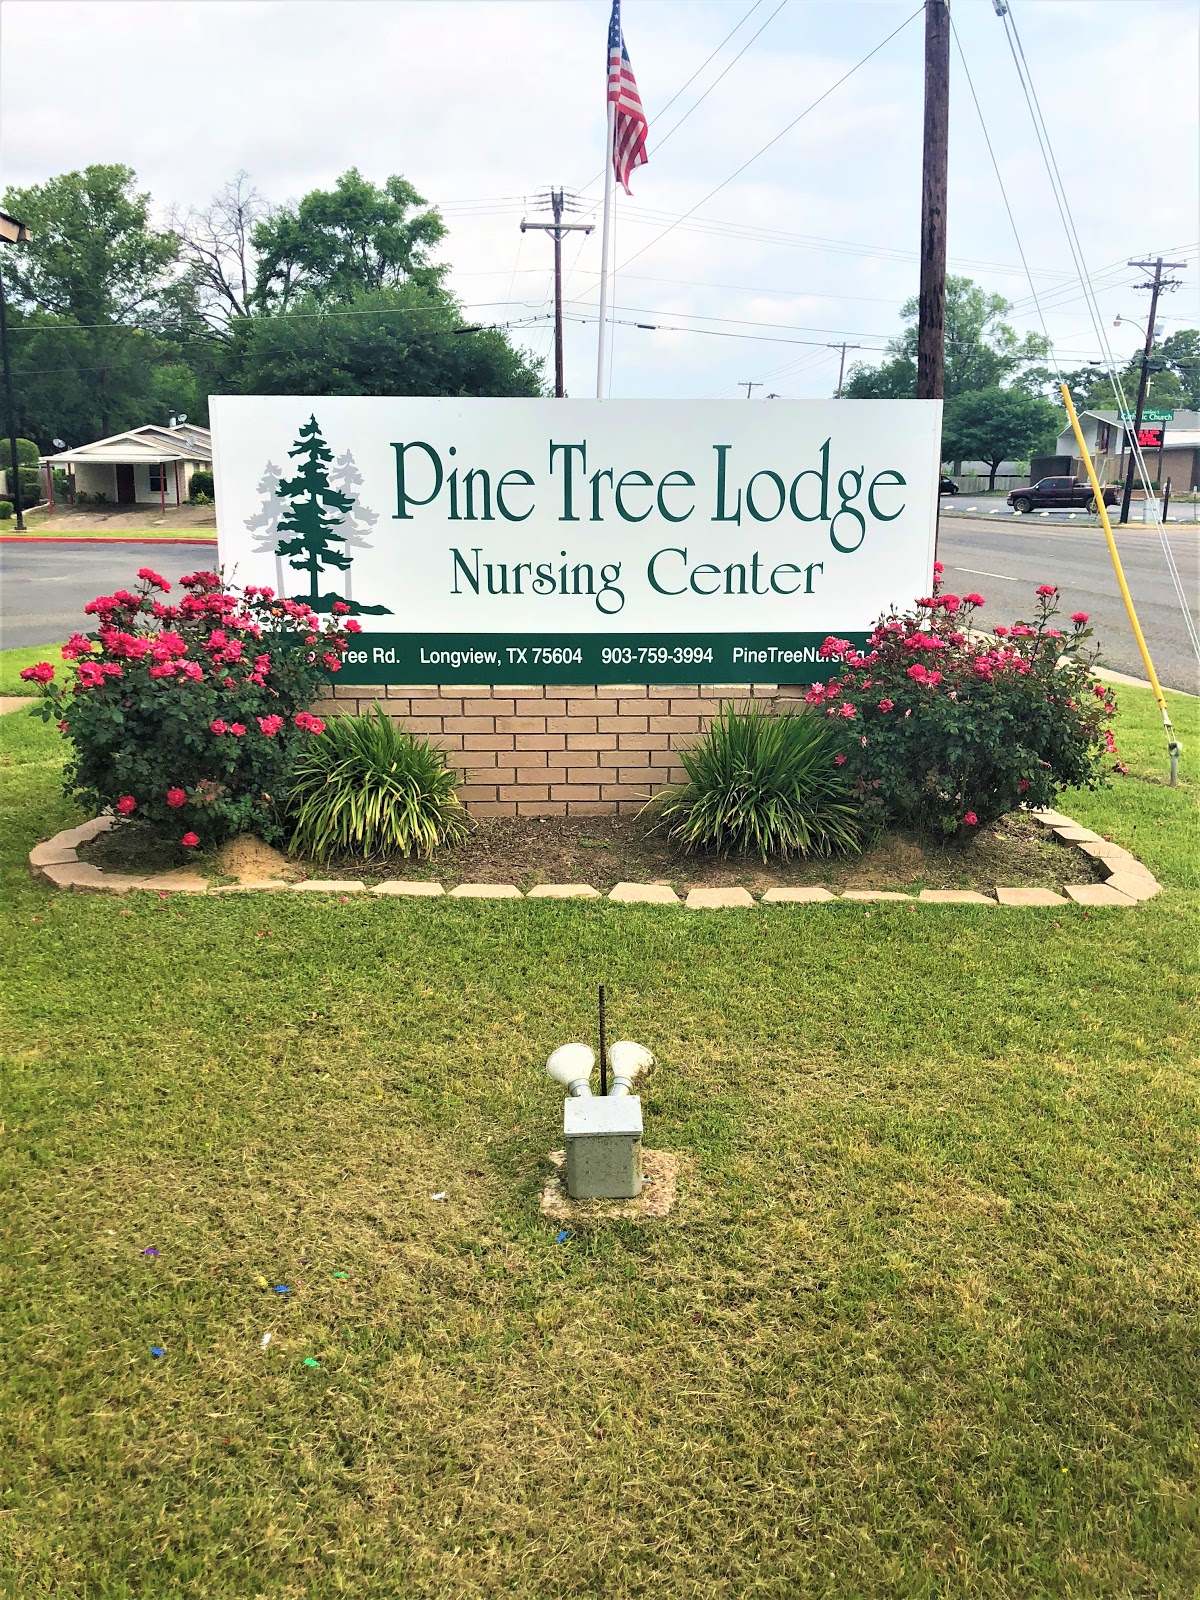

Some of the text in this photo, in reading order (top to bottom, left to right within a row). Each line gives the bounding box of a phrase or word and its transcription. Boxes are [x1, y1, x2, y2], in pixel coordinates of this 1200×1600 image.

[390, 437, 907, 554] Pine Tree Lodge
[450, 548, 824, 615] Nursing Center
[333, 648, 368, 664] ree
[372, 647, 401, 664] Rd.
[420, 647, 502, 668] Longview,
[506, 648, 528, 664] TX
[532, 648, 583, 664] 75604
[601, 647, 714, 664] 903-759-3994
